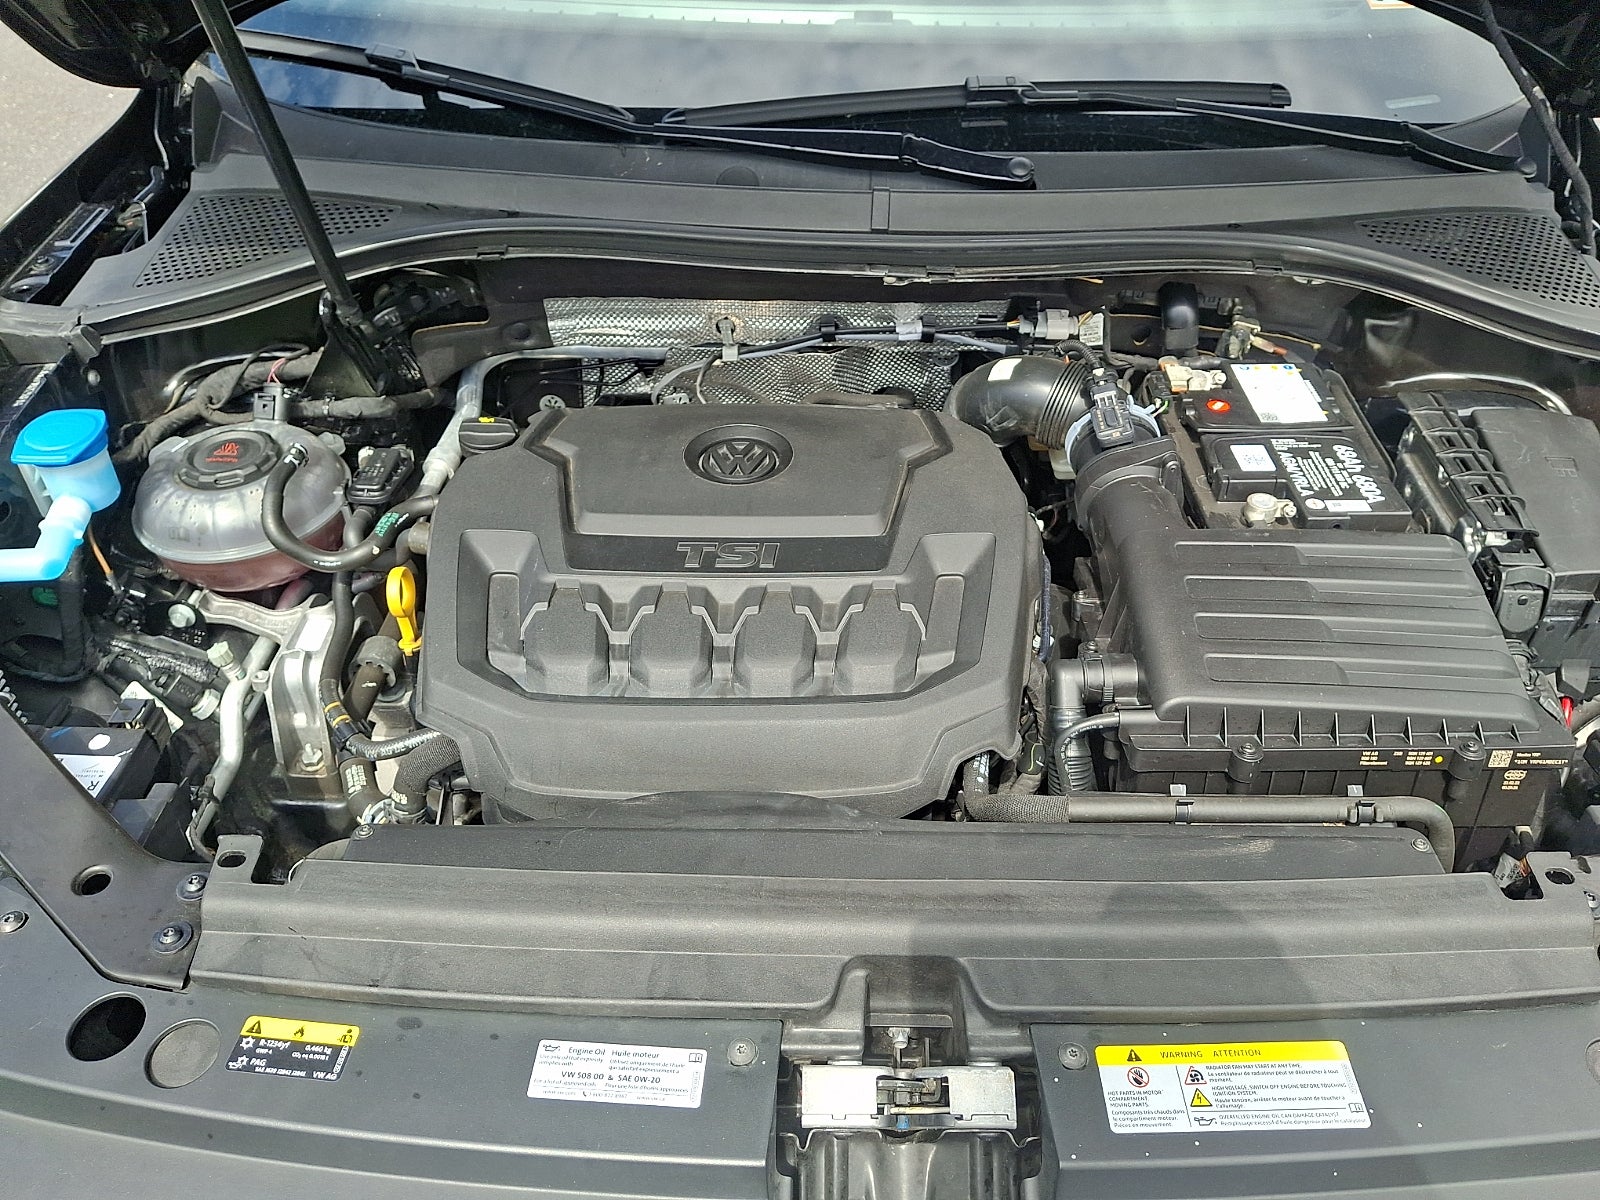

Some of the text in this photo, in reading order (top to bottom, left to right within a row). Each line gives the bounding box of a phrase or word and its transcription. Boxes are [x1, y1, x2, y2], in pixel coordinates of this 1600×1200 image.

[1332, 444, 1367, 479] 68Ah
[1352, 474, 1386, 504] 680A
[677, 541, 780, 569] TSI
[258, 1039, 291, 1050] R-1234yf
[567, 1046, 593, 1055] Engine
[1213, 1049, 1262, 1057] ATTENTION
[325, 1072, 338, 1080] AG
[633, 1075, 660, 1083] 0W-20
